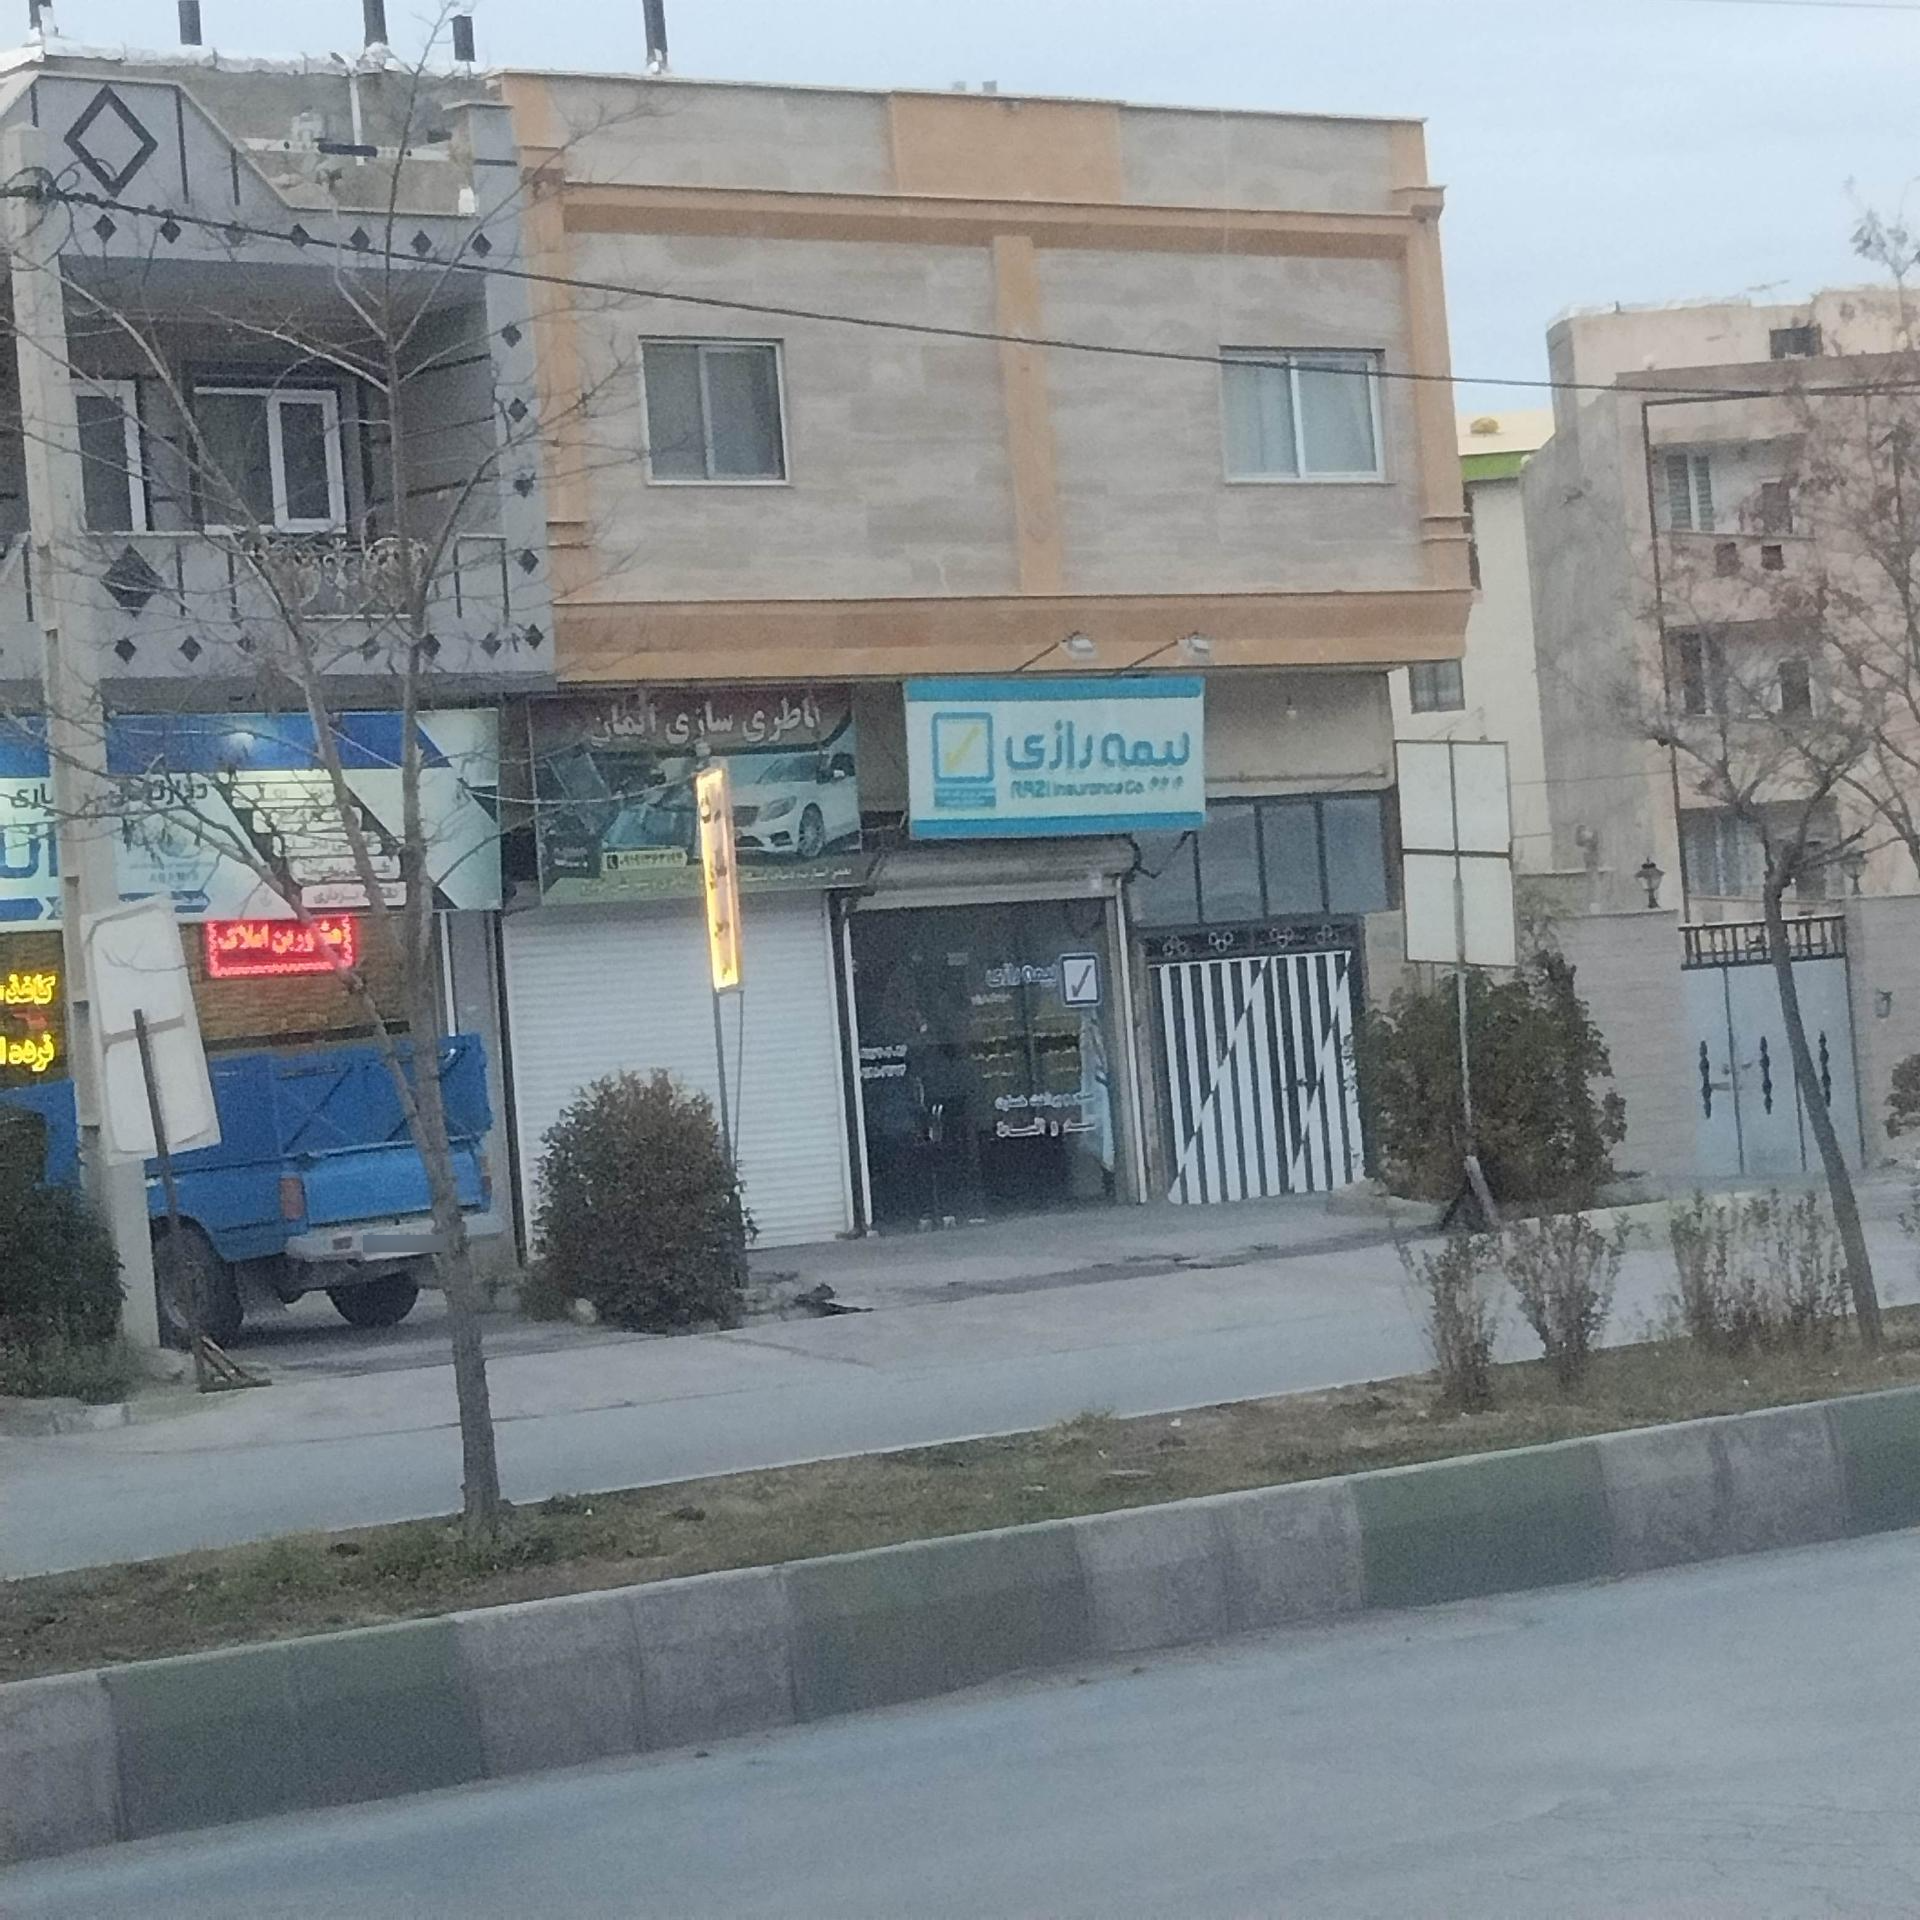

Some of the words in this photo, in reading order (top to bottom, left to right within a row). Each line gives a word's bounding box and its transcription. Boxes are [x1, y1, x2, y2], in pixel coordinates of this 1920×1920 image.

[666, 701, 733, 744] سازی
[1005, 719, 1093, 770] رازی
[217, 923, 269, 951] املاک
